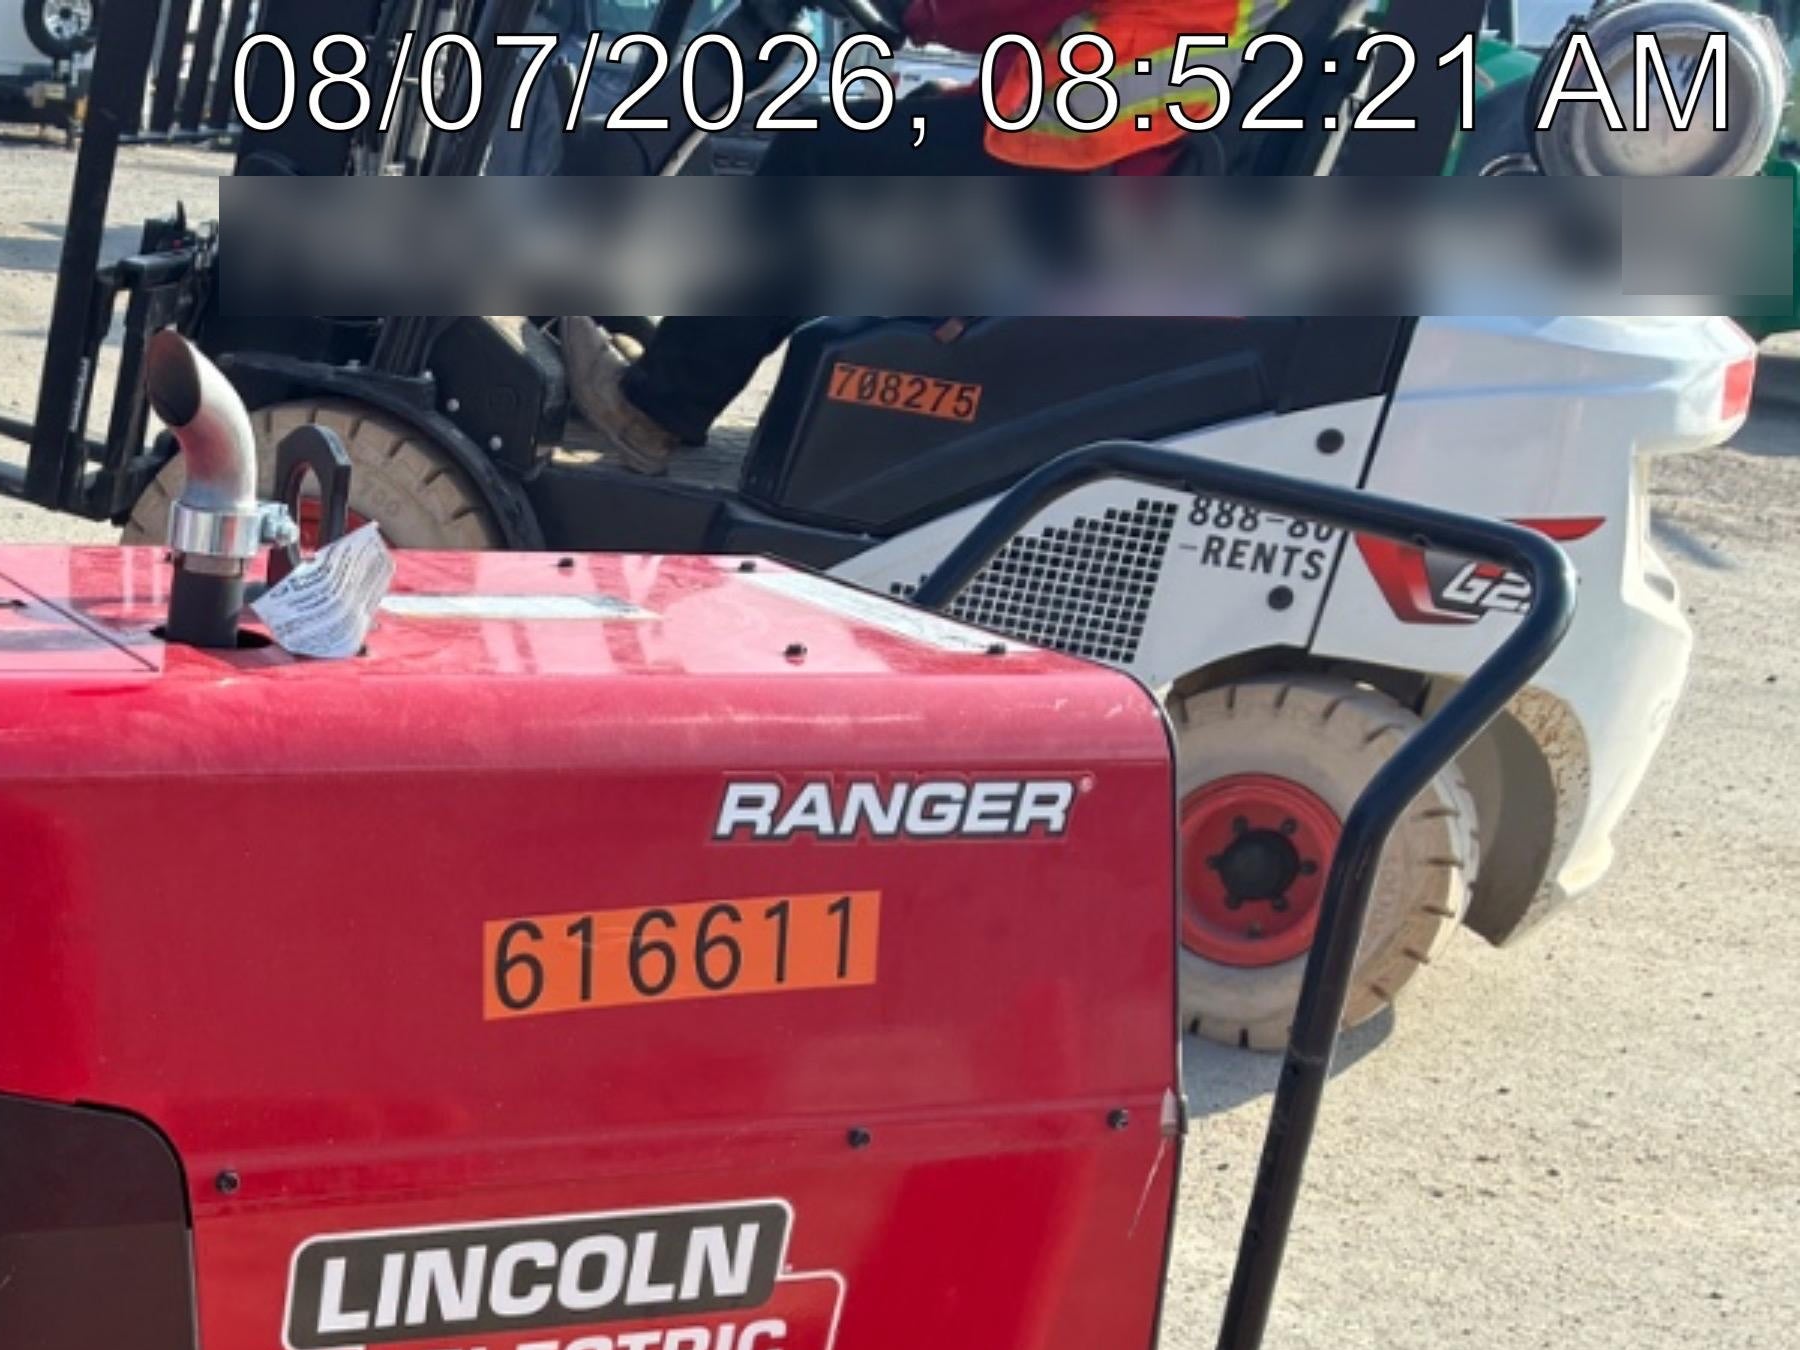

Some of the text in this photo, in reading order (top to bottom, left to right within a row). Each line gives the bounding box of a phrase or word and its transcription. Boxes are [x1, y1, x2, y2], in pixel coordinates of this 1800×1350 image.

[836, 365, 976, 418] 708275
[1178, 534, 1326, 580] -RENTS
[1442, 560, 1532, 614] G2
[712, 778, 1075, 840] RANGER
[494, 895, 852, 1010] 616611
[316, 1222, 760, 1333] LINCOLN
